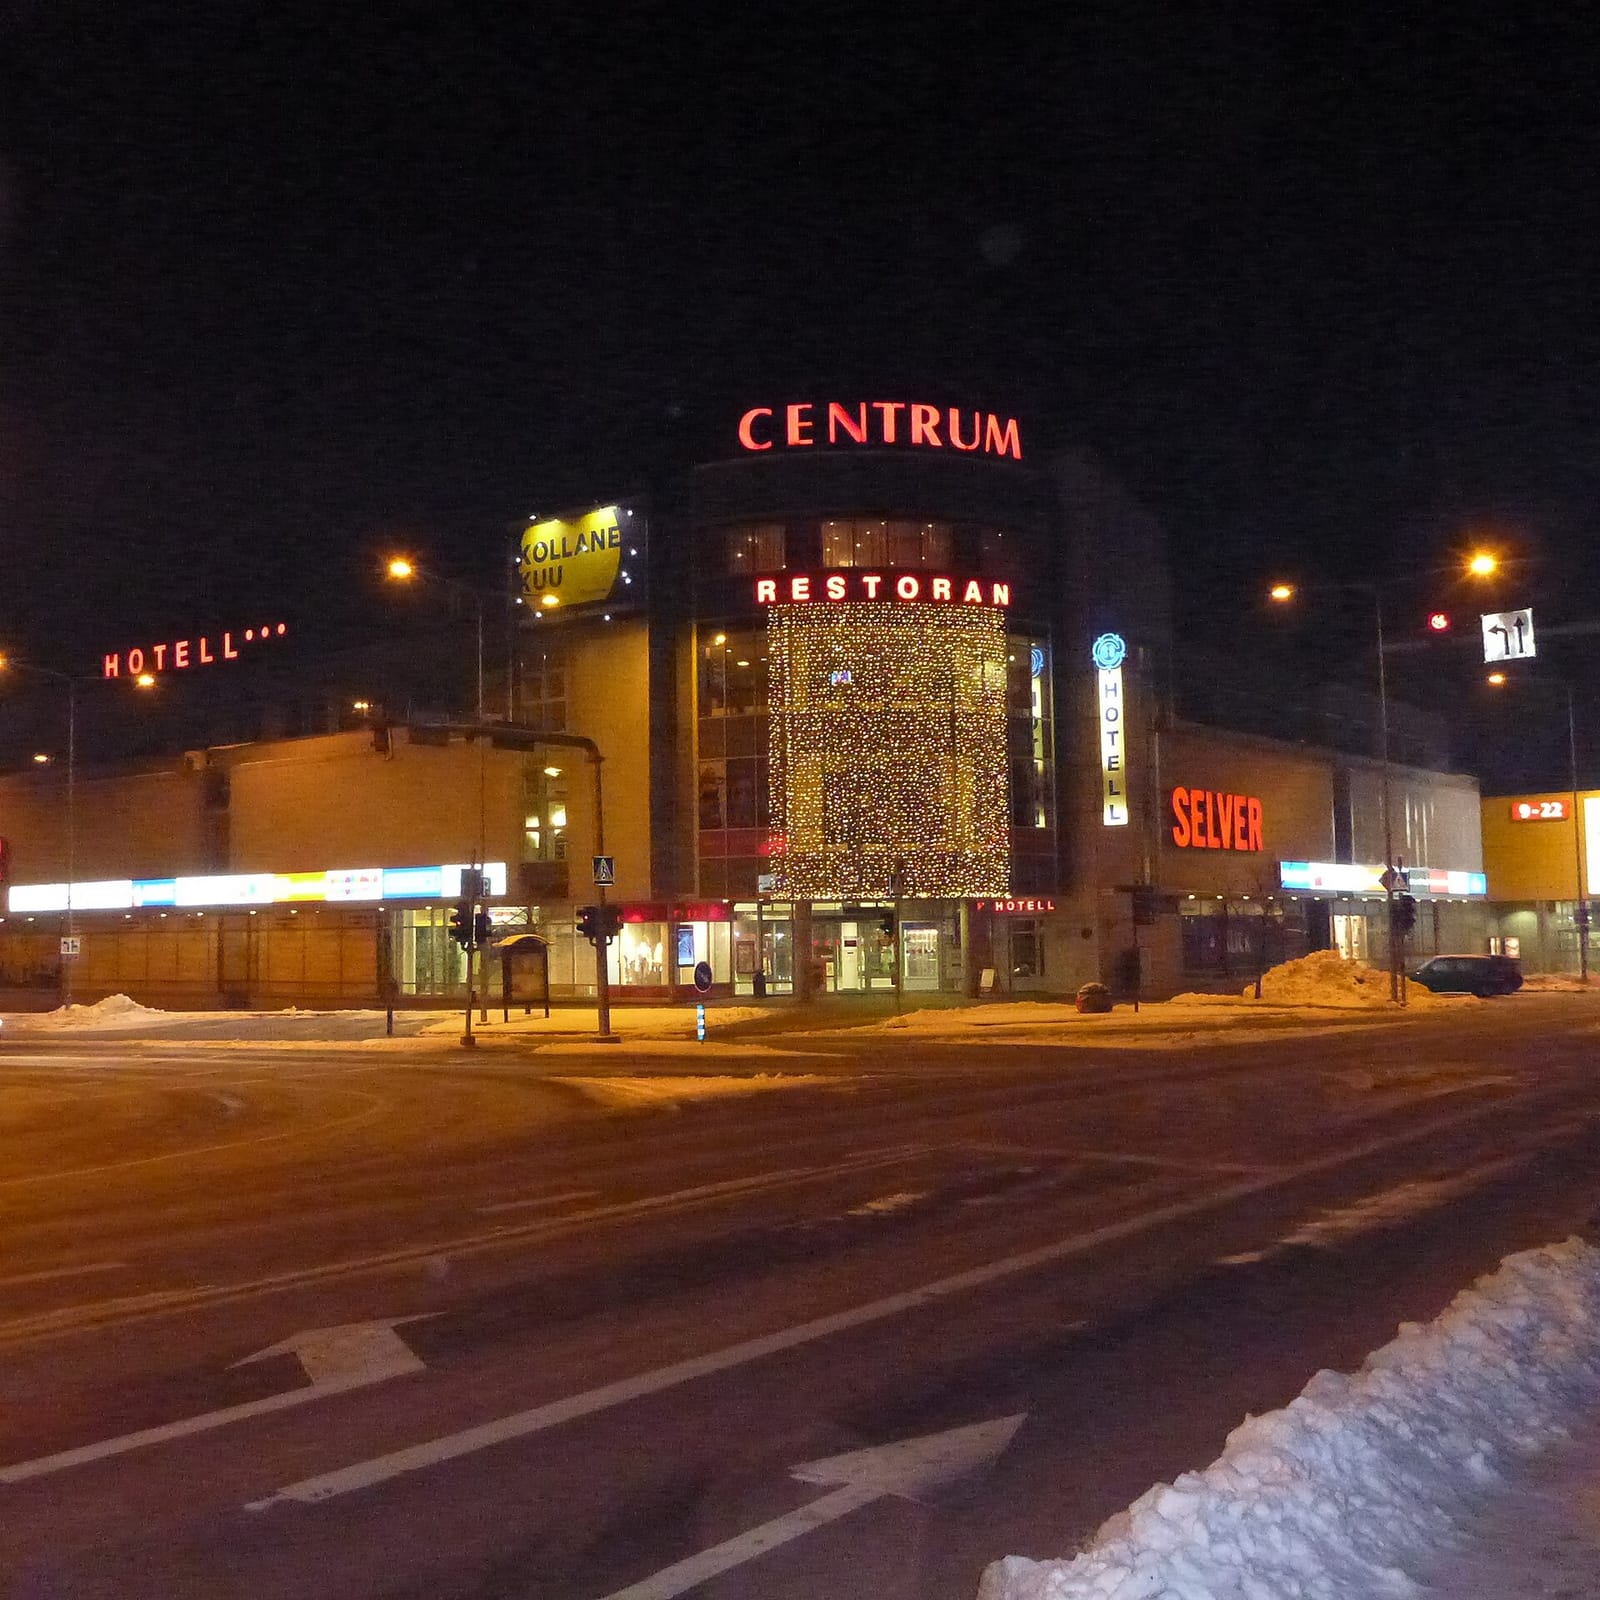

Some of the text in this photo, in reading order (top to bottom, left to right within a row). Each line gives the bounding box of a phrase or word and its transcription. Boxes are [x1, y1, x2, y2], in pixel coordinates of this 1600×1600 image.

[738, 402, 1022, 460] CENTRUM
[521, 525, 621, 566] KOLLANE
[757, 576, 1010, 606] RESTORAN
[104, 632, 239, 679] HOTELL
[1104, 682, 1121, 821] HOTELL
[1172, 786, 1264, 851] SELVER
[1518, 801, 1564, 819] 9-22
[995, 900, 1055, 912] HOTELL
